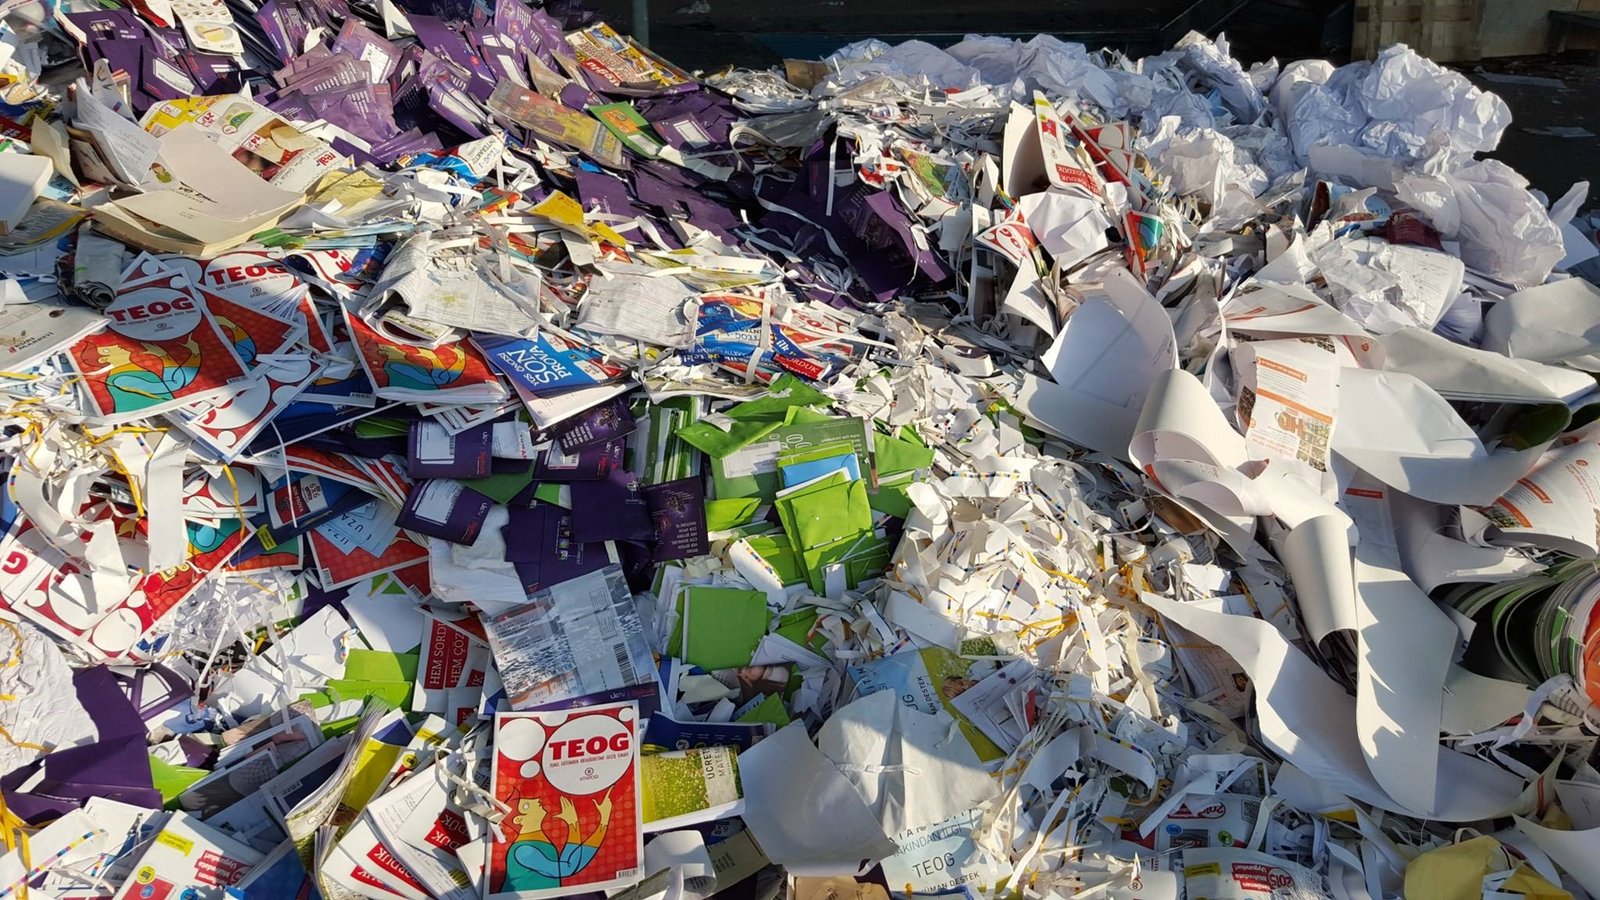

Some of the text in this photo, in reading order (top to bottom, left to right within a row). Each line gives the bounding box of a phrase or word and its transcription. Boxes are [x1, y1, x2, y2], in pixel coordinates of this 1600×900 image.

[207, 265, 288, 285] TEOG
[107, 297, 194, 321] TEOG
[506, 349, 559, 383] SON
[530, 345, 572, 379] PROVA
[523, 373, 539, 386] YGS
[450, 632, 466, 683] HEM ÇÖZ
[430, 660, 443, 685] HEM
[549, 733, 629, 760] TEOG
[432, 831, 460, 849] DUK
[913, 853, 955, 878] TEOG
[950, 872, 980, 887] DESTEK
[1270, 873, 1293, 888] 2015
